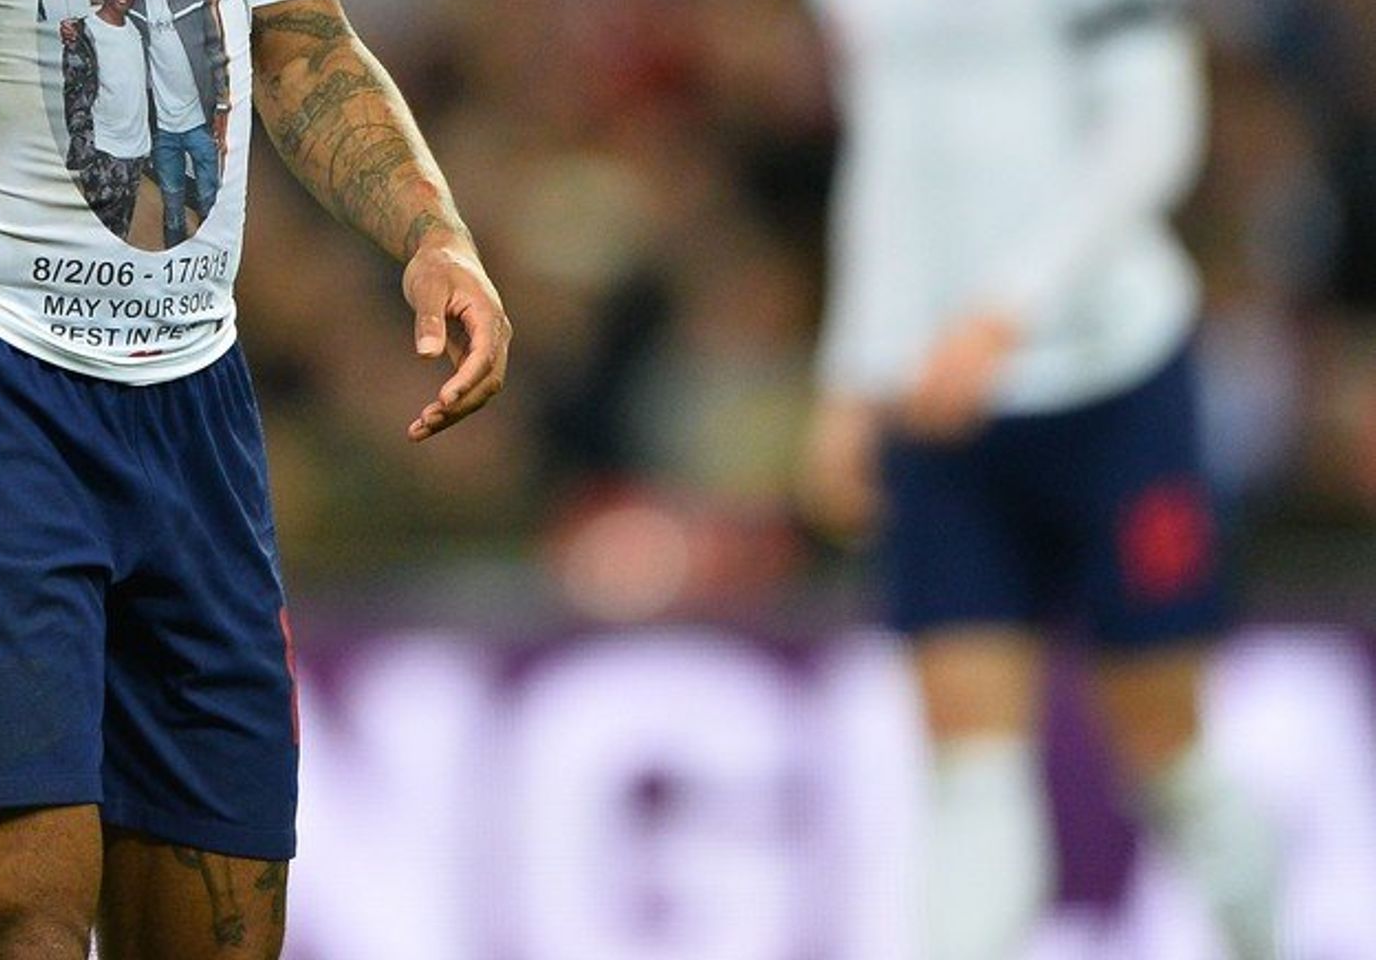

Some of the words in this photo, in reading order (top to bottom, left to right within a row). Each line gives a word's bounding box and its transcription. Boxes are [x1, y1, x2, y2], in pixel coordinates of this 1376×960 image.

[33, 257, 135, 287] 8/2/06
[44, 295, 101, 318] MAY
[109, 297, 175, 318] YOUR
[126, 328, 151, 345] IN
